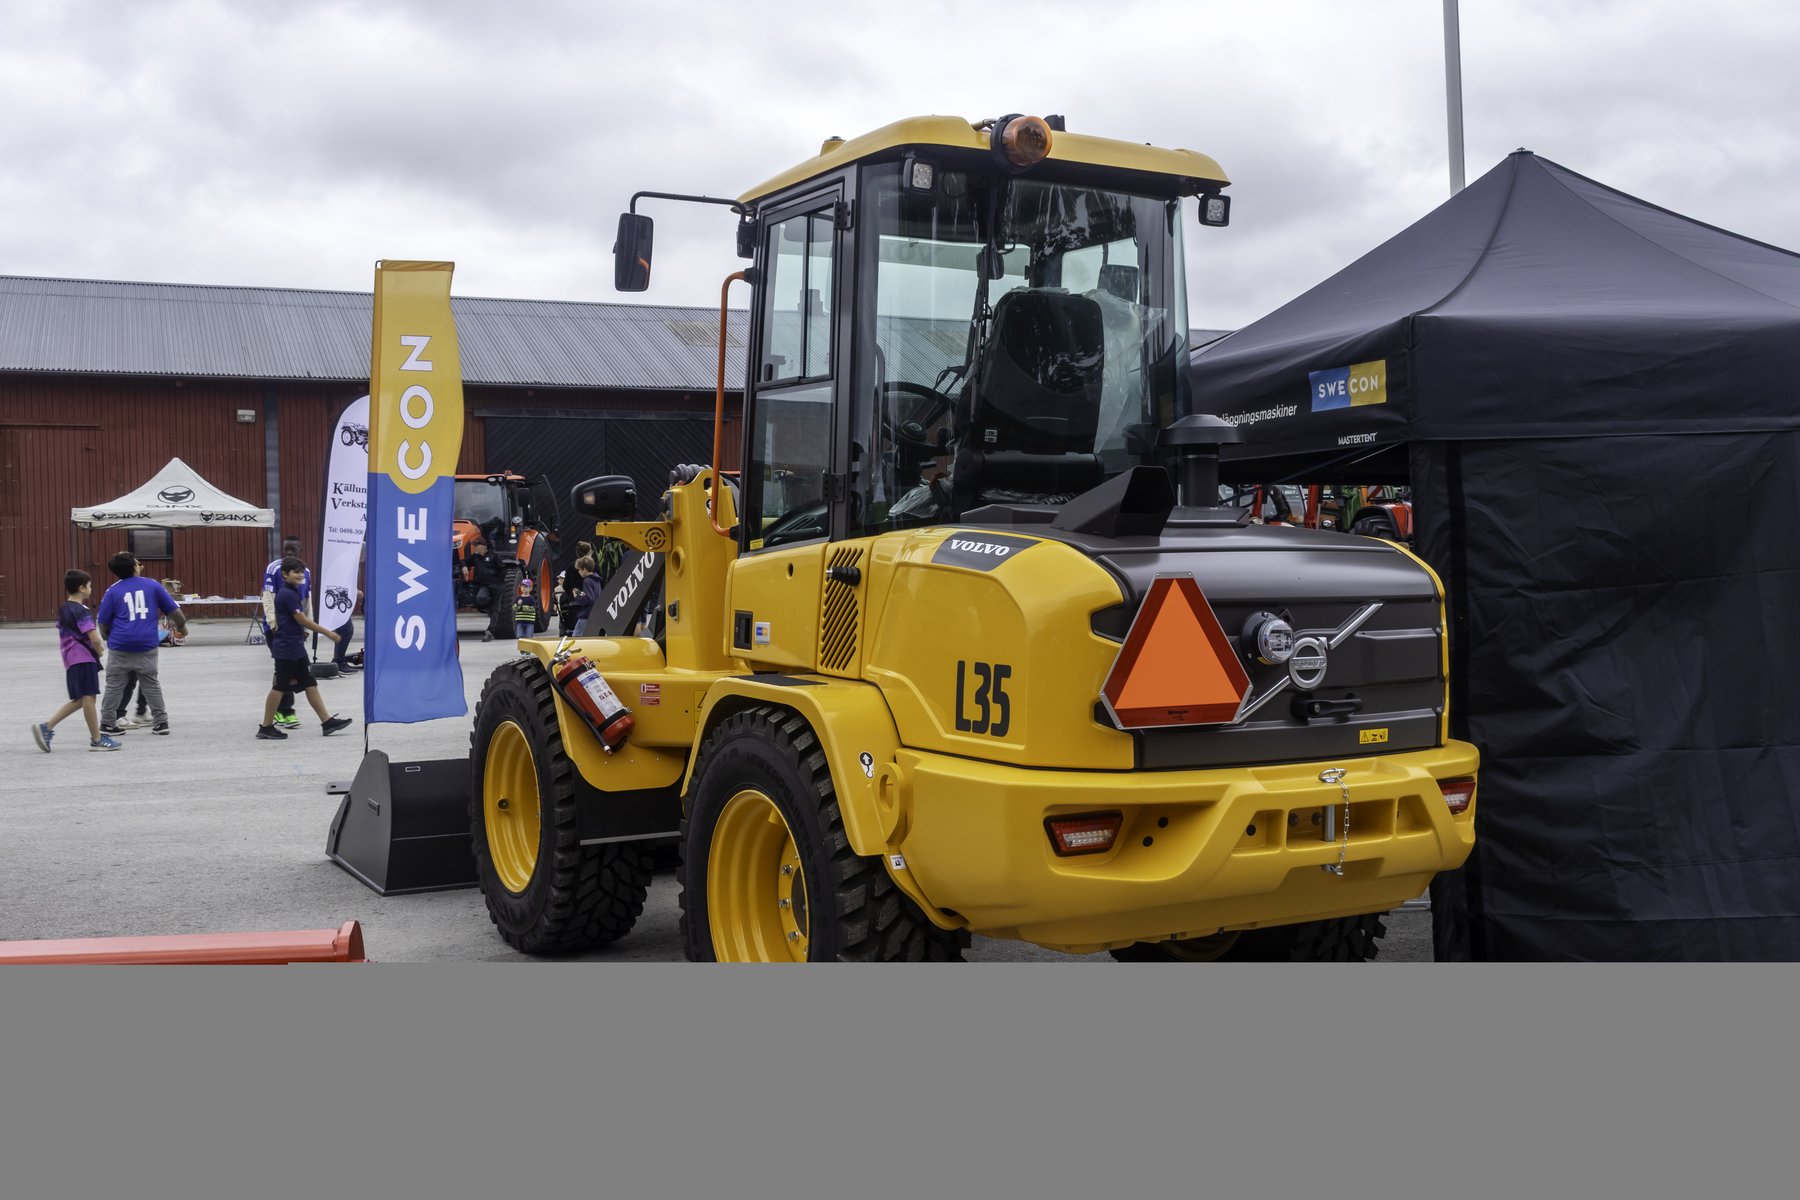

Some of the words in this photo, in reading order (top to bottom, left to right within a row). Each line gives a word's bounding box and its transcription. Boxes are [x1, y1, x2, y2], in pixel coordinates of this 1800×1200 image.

[1318, 374, 1379, 399] SWECON
[1221, 403, 1298, 428] läggningsmaskiner
[1337, 432, 1377, 446] MASTERTENT
[332, 482, 367, 495] Källun
[394, 334, 435, 652] SWECON
[214, 513, 258, 522] 24MX
[950, 539, 1010, 556] VOLVO
[606, 551, 655, 620] VOLVO
[123, 589, 149, 622] 14
[955, 660, 1012, 738] L35
